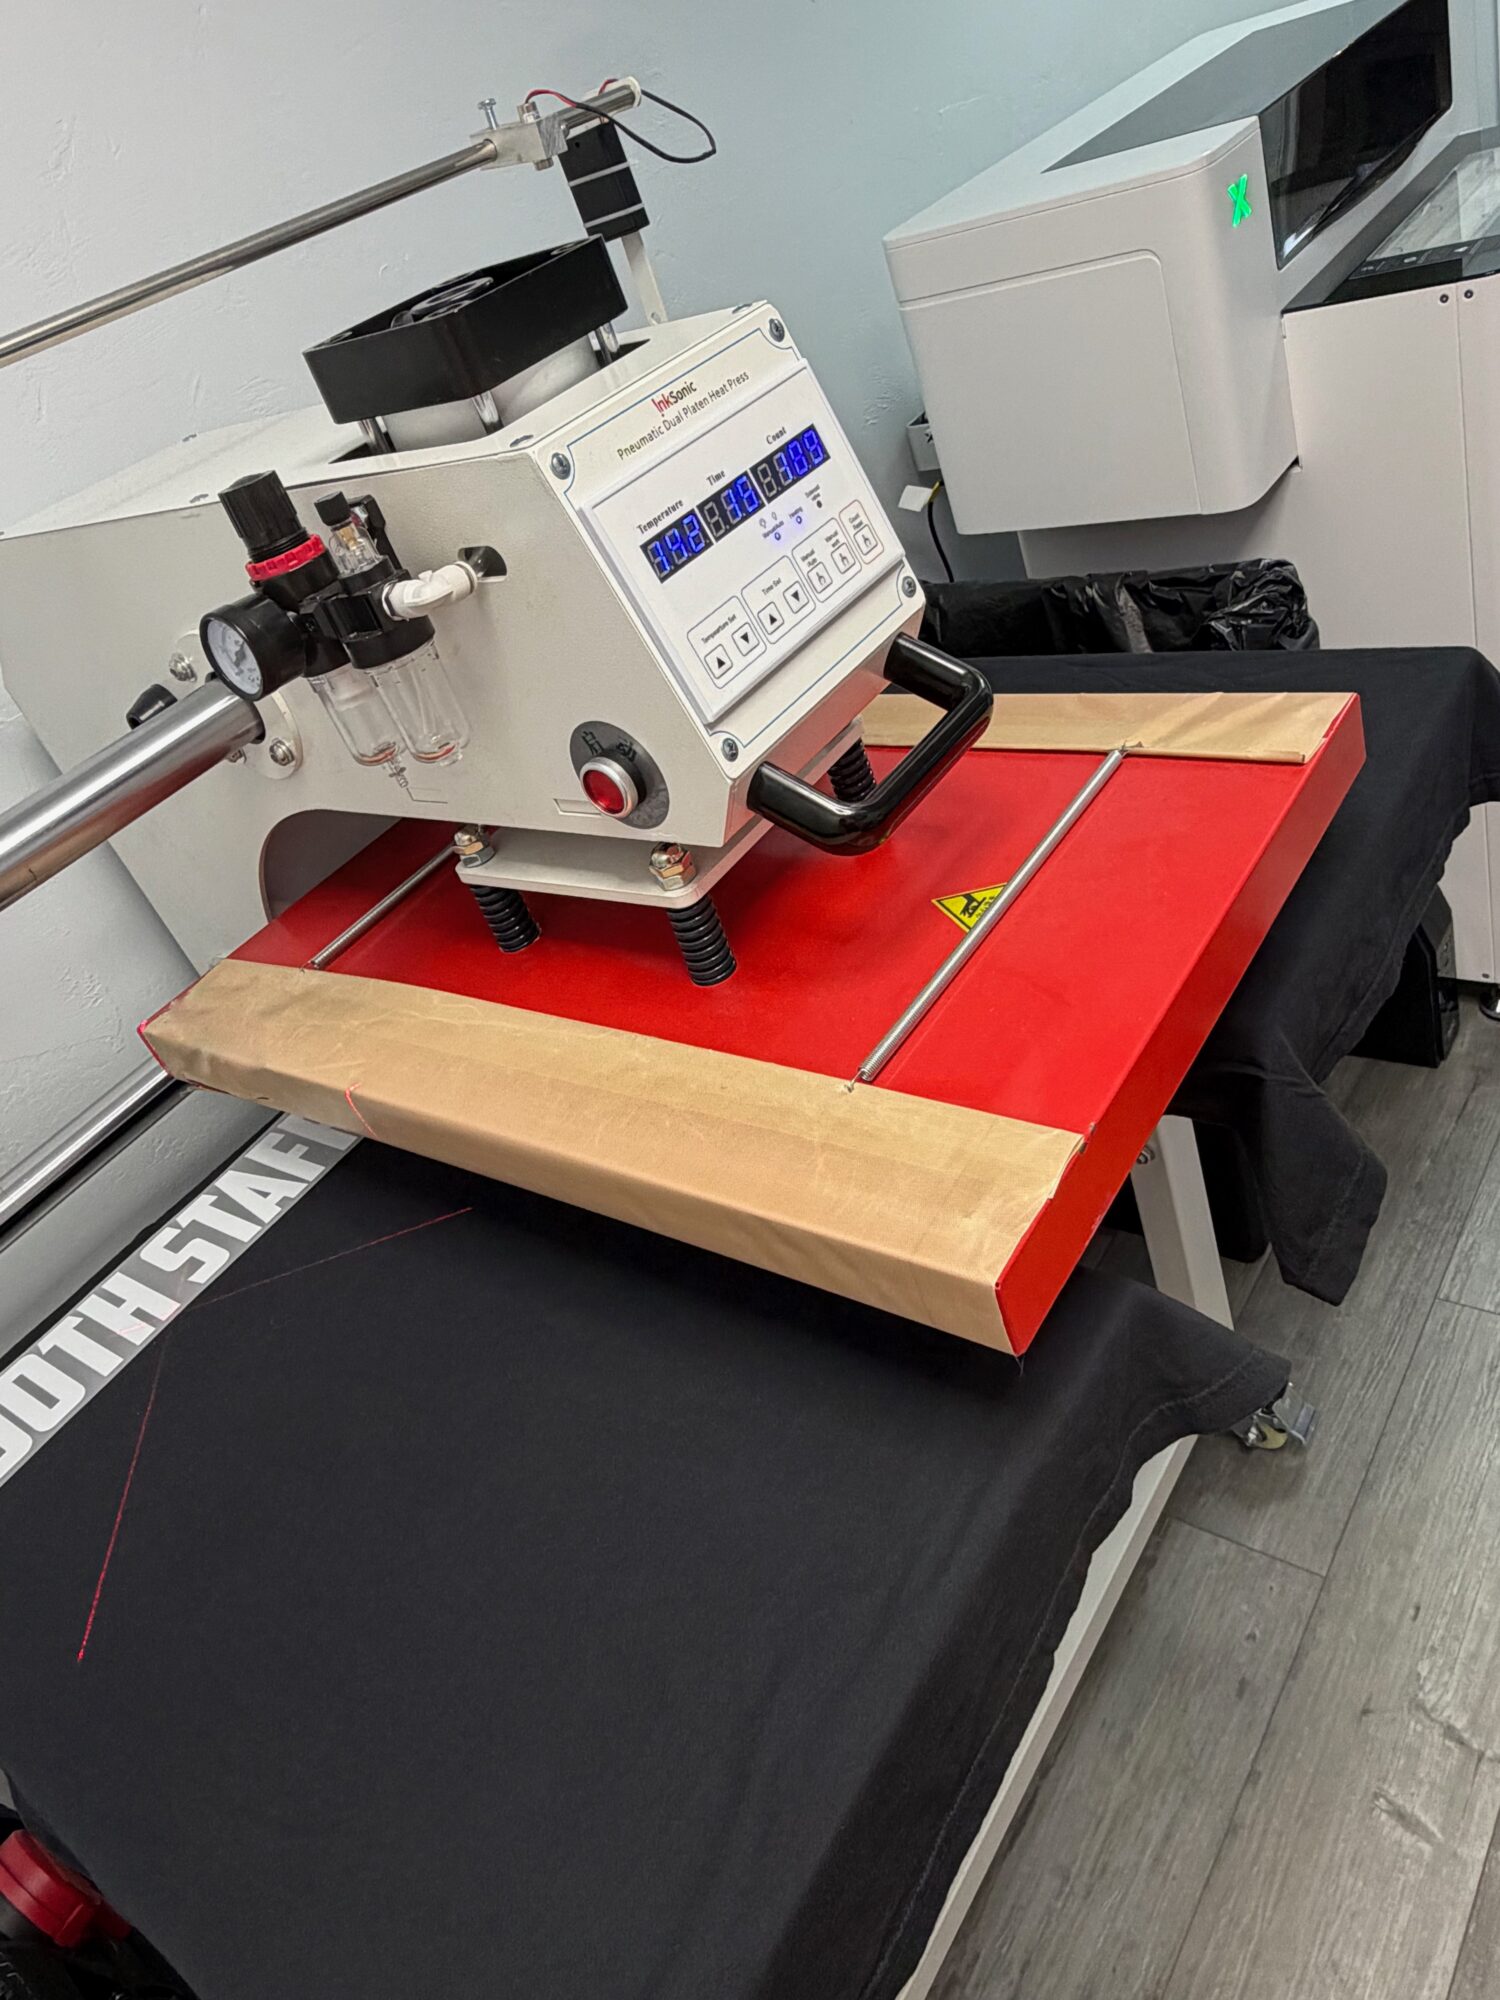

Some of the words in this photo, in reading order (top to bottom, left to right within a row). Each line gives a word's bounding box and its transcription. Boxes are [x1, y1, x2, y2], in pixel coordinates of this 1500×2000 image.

[617, 425, 665, 460] Pneumatic
[662, 414, 685, 431] Dual
[682, 398, 710, 419] Platen
[707, 383, 730, 401] Heat
[727, 371, 750, 390] Press
[651, 381, 697, 417] InkSonic
[766, 426, 787, 445] Count
[706, 469, 726, 486] Time
[636, 499, 684, 535] Temperature
